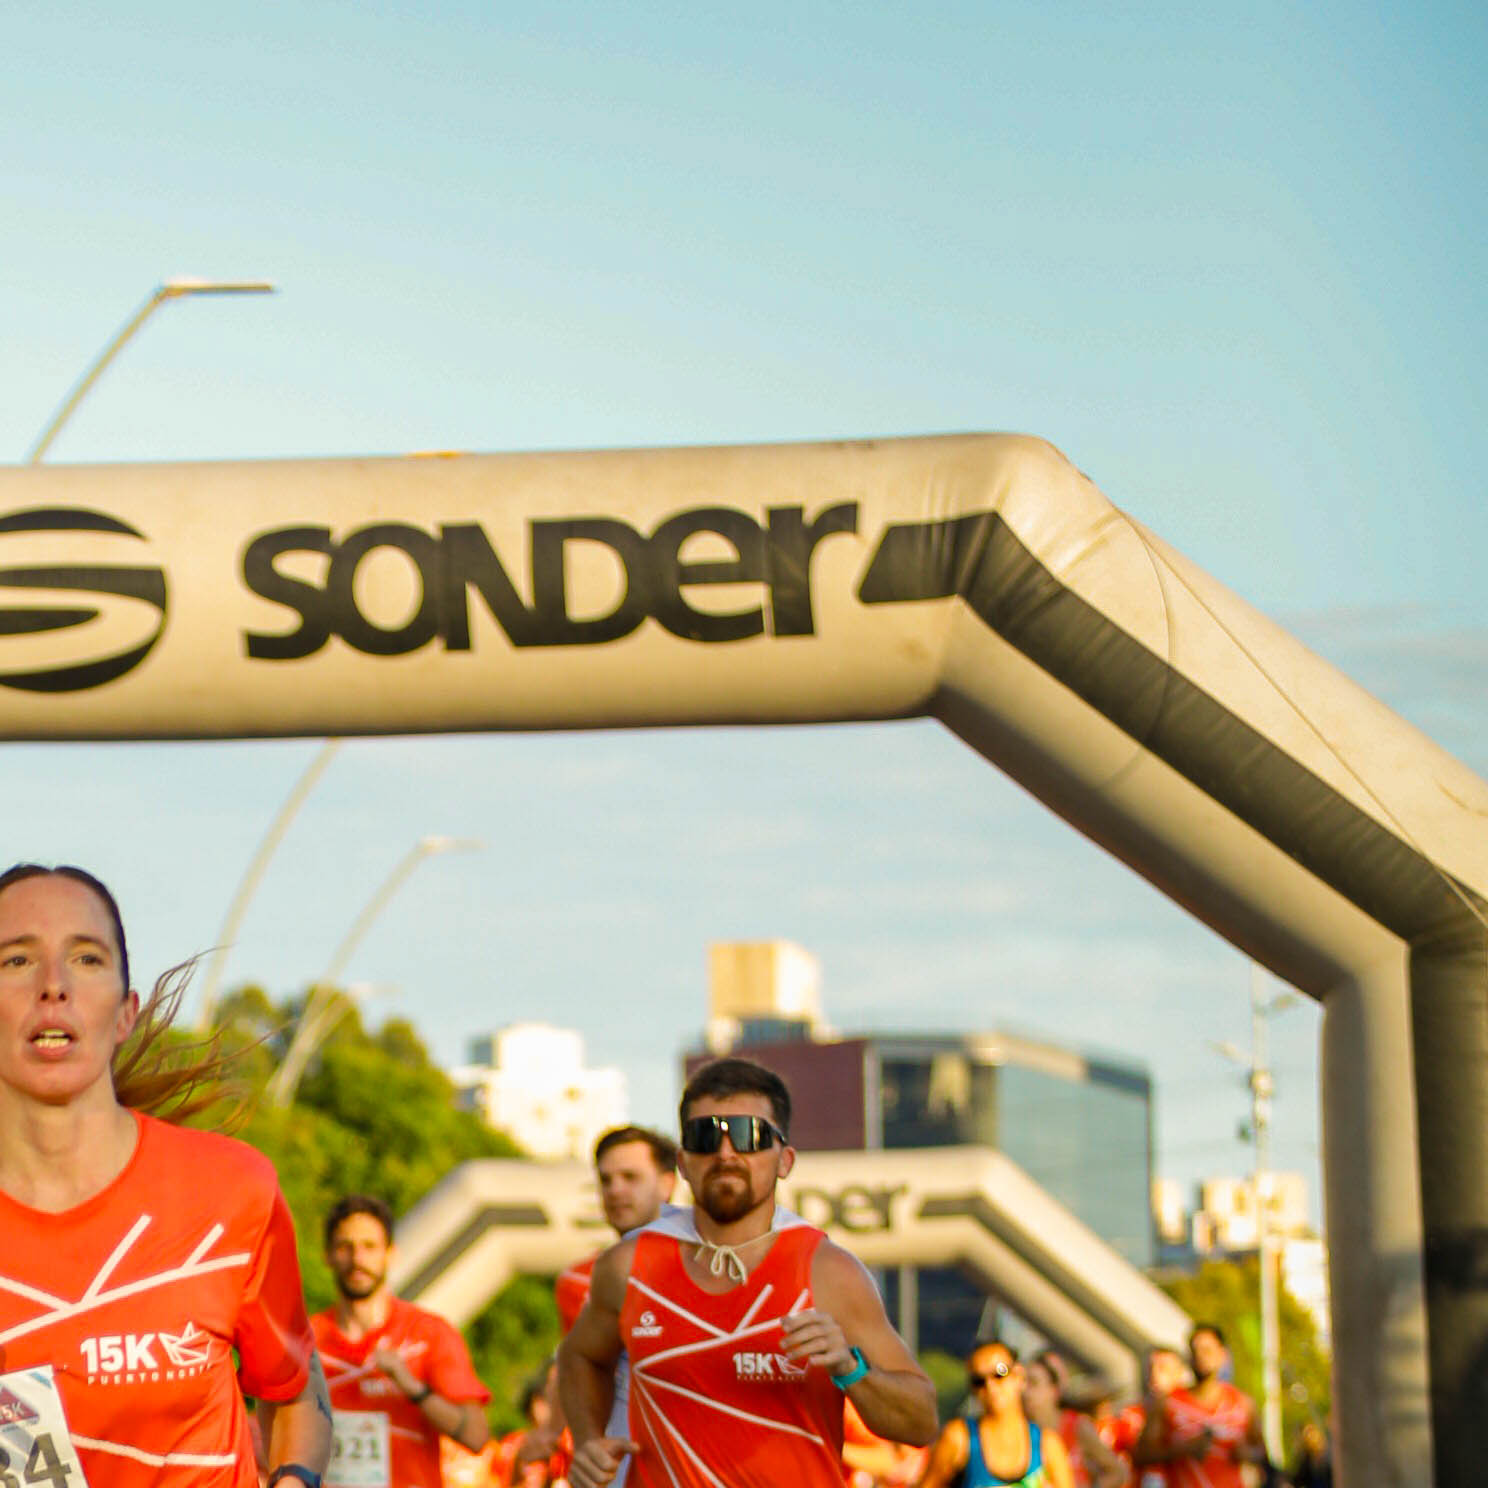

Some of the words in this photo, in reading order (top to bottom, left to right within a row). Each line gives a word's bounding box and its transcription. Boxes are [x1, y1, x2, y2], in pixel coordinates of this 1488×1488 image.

[80, 1332, 158, 1374] 15K
[733, 1352, 773, 1375] 15K
[87, 1372, 160, 1386] PUERTO
